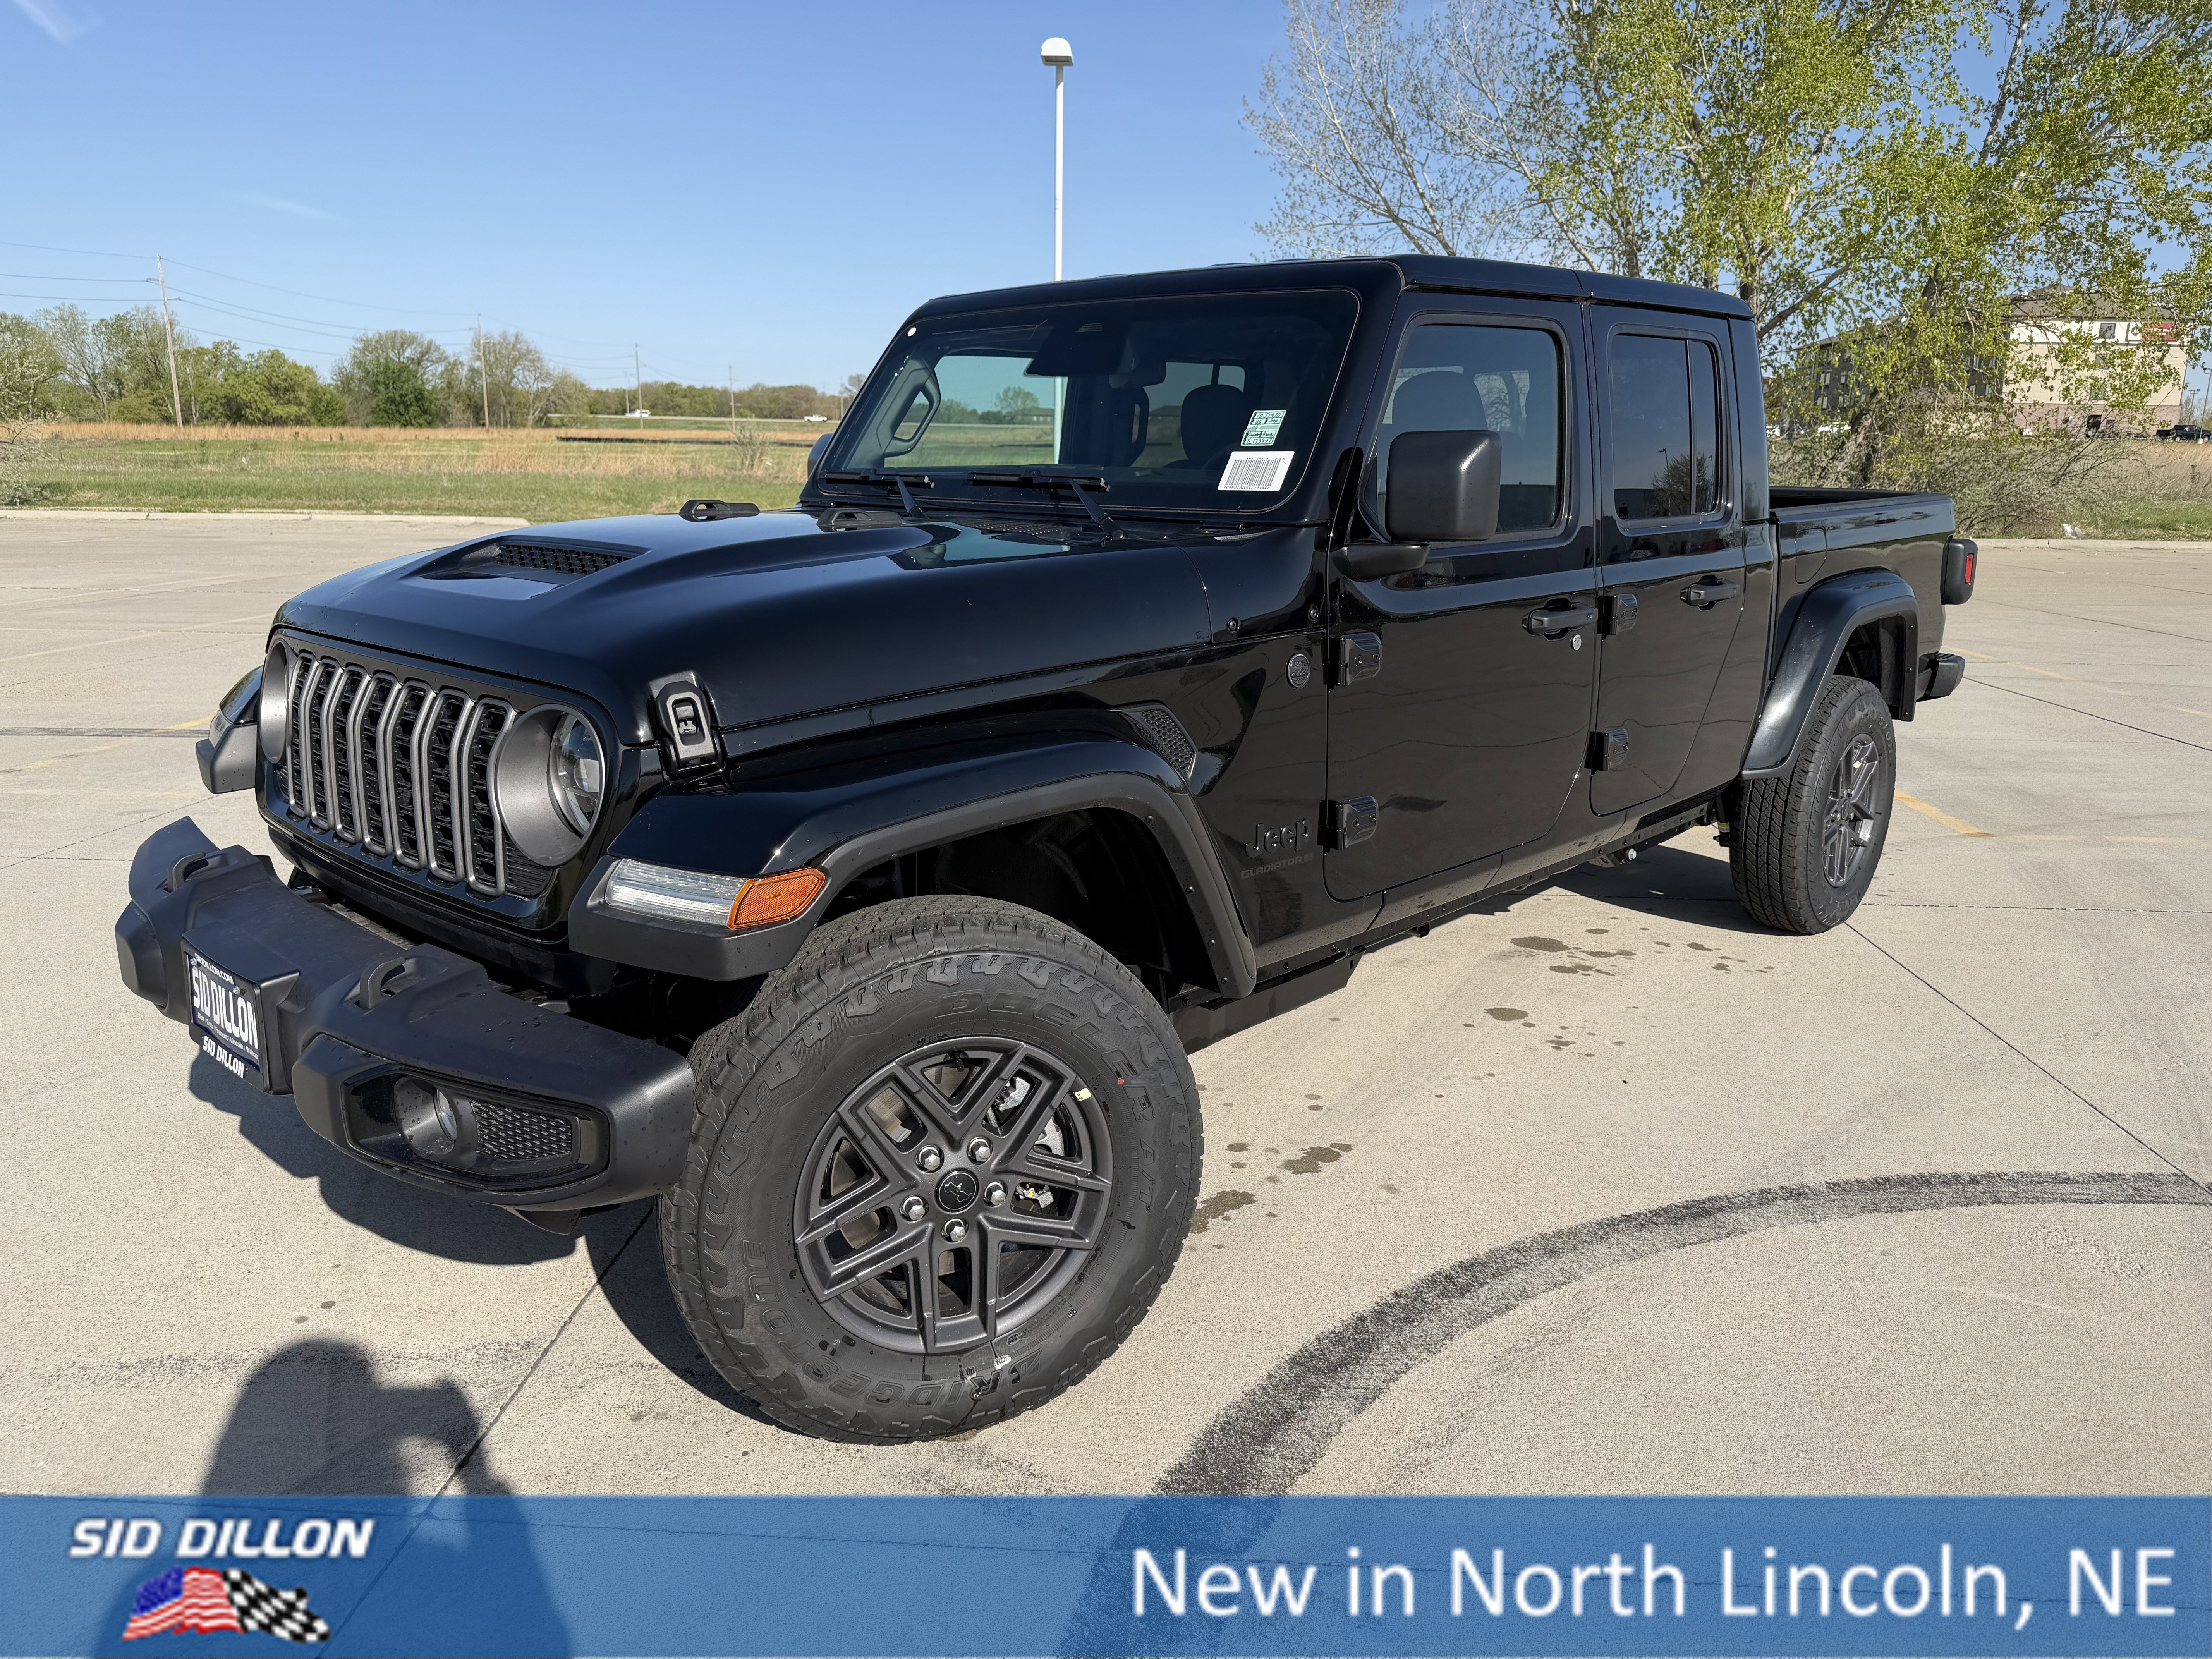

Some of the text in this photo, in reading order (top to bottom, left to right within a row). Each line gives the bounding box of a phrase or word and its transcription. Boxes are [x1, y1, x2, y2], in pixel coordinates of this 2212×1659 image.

[1241, 857, 1302, 879] GLADIATOR
[1244, 817, 1313, 859] Jeep
[192, 966, 259, 1050] SID DILLON
[203, 1036, 245, 1079] SID DILLON
[931, 989, 1156, 1123] DUELER
[1139, 1137, 1156, 1212] A/T
[741, 1238, 1044, 1411] BRIDGESTONE
